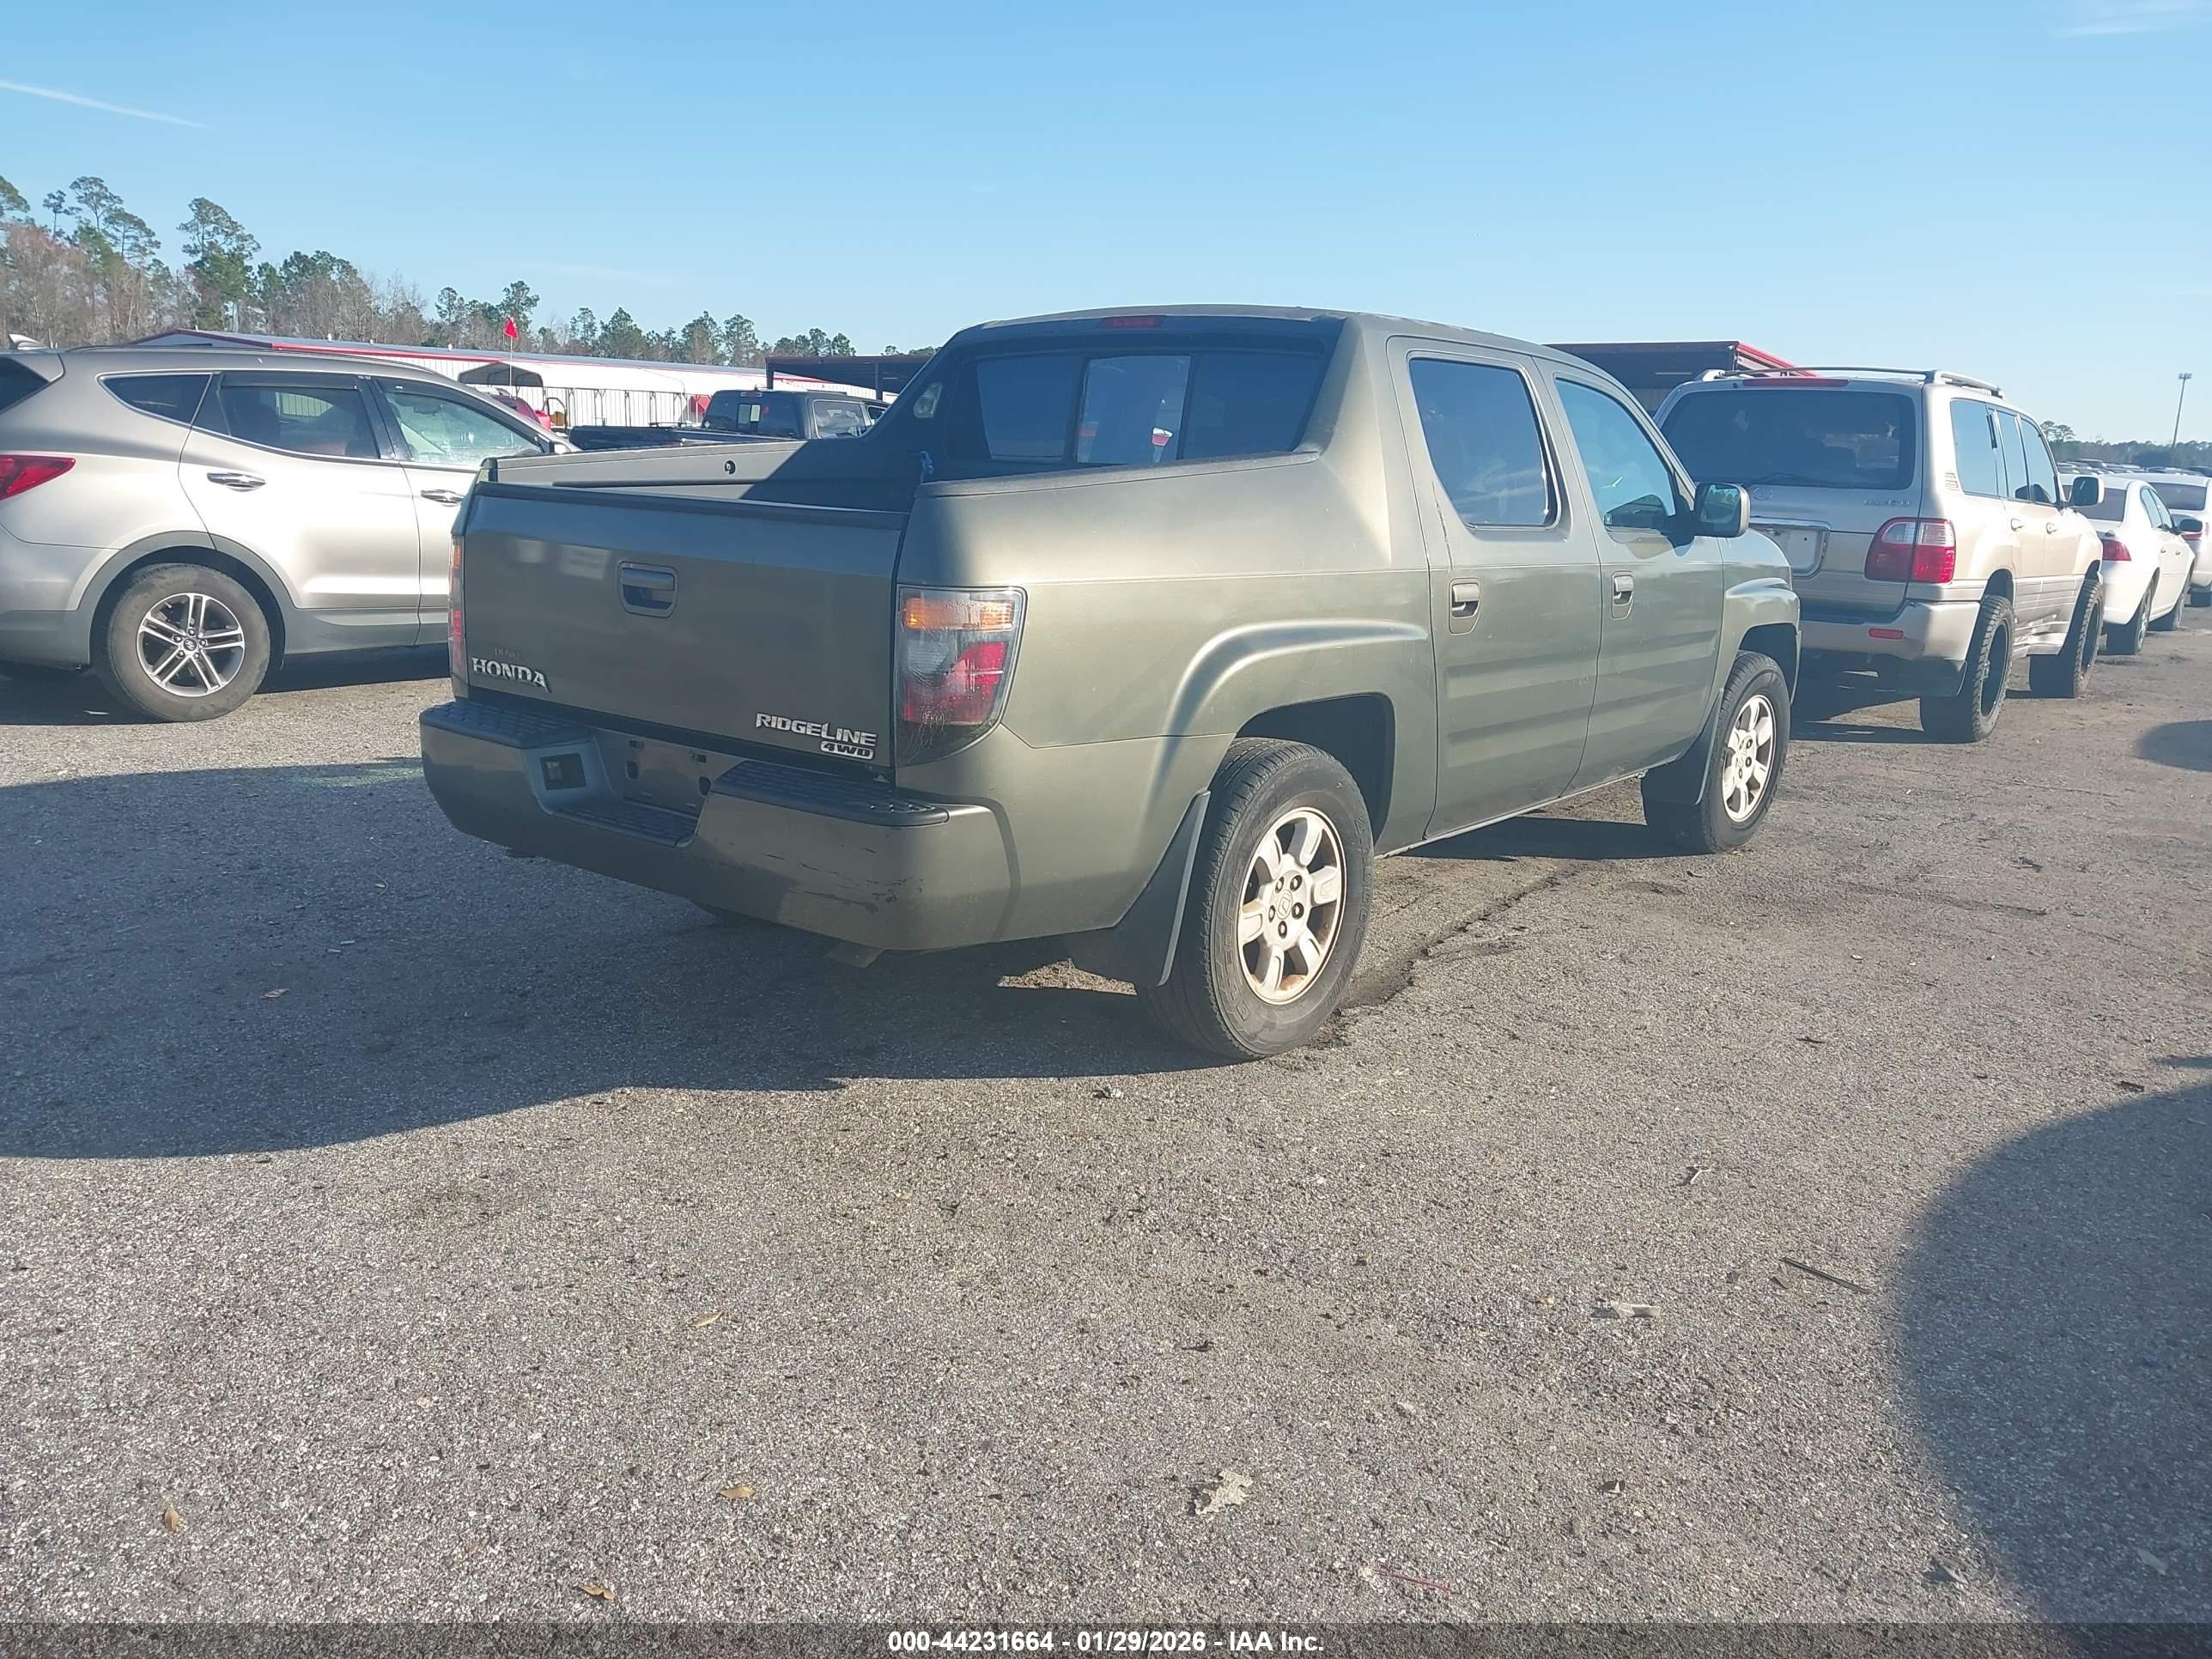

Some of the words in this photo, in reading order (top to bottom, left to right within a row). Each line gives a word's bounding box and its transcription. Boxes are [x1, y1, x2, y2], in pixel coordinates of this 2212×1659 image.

[471, 657, 550, 693] HONDA
[756, 713, 878, 747] RIDGELINE
[822, 741, 872, 759] 4WD
